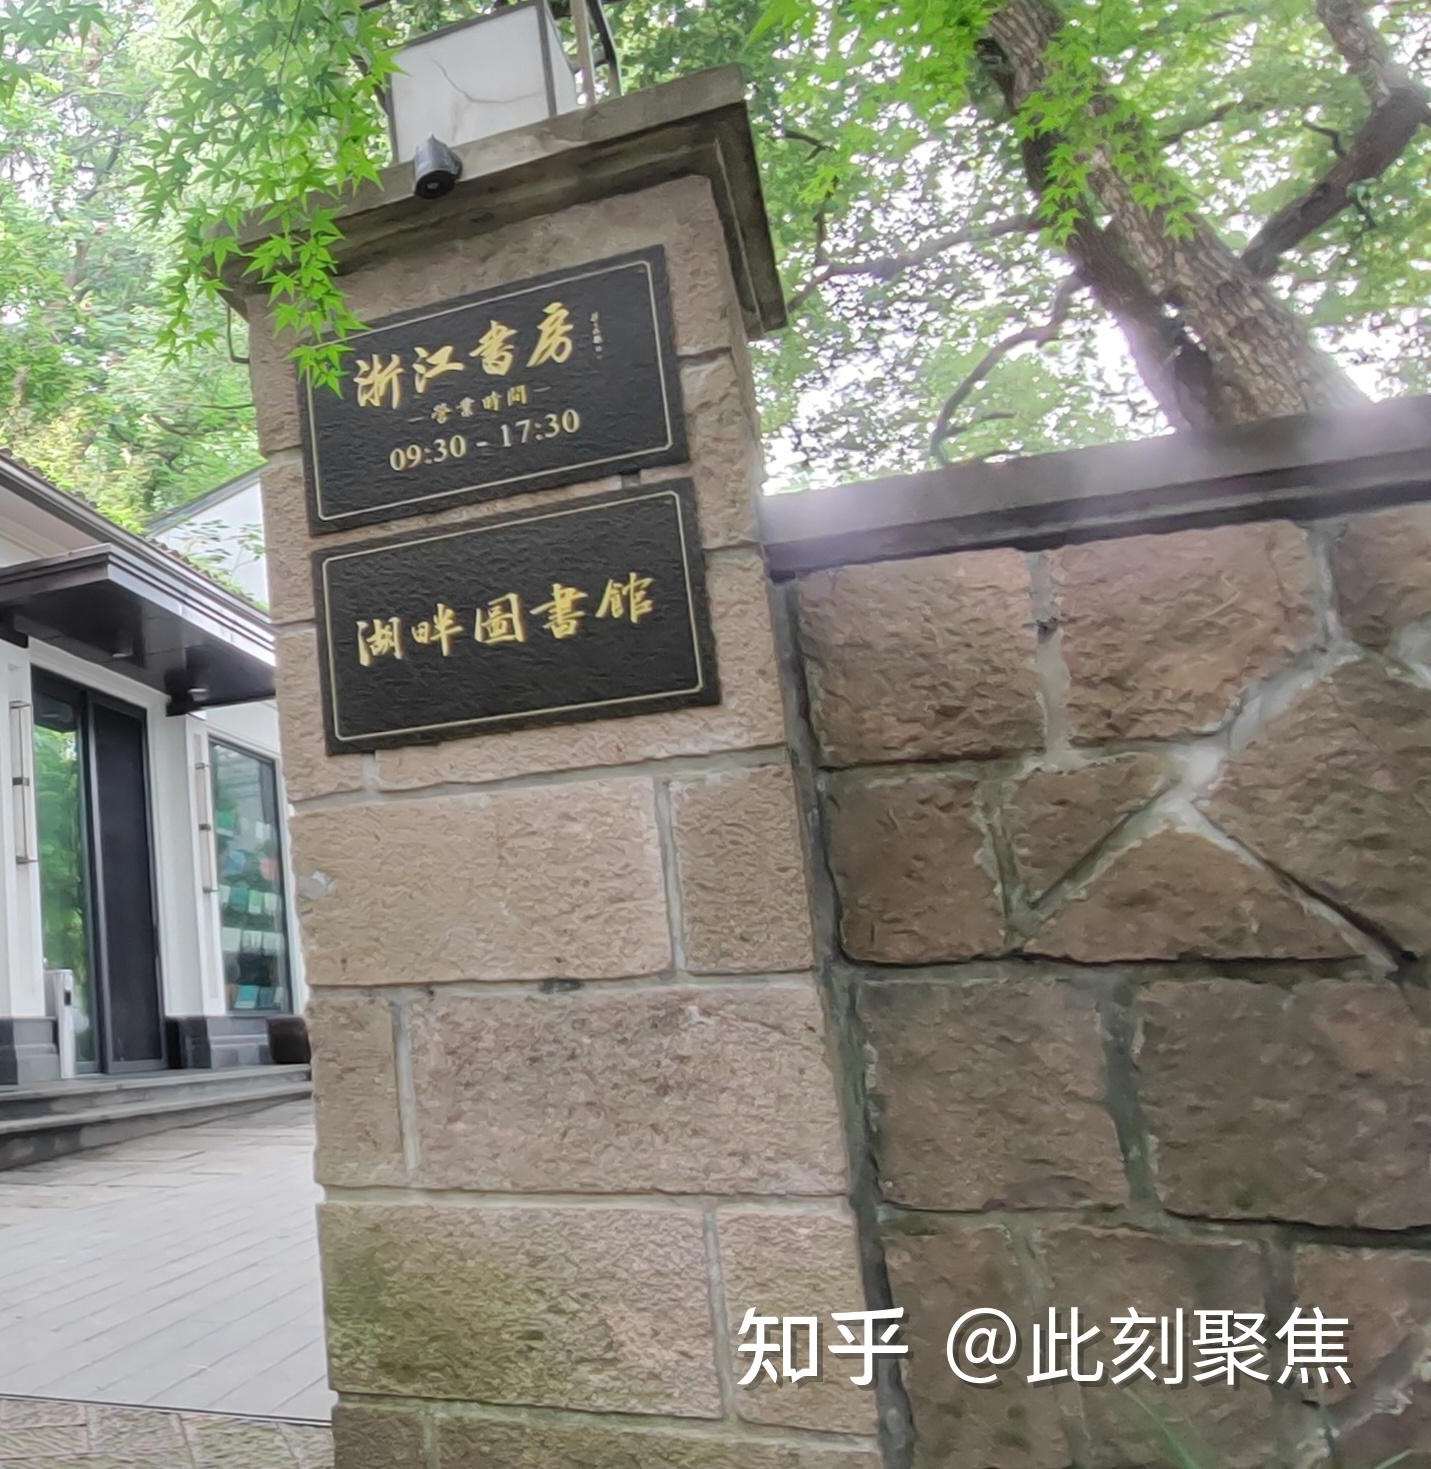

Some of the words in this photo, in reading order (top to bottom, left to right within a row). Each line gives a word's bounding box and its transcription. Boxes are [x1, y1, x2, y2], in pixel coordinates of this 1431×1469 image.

[353, 301, 574, 410] 浙江書房
[389, 434, 467, 472] 09:30
[499, 408, 581, 448] 17:30
[357, 572, 655, 667] 湖畔圖書館
